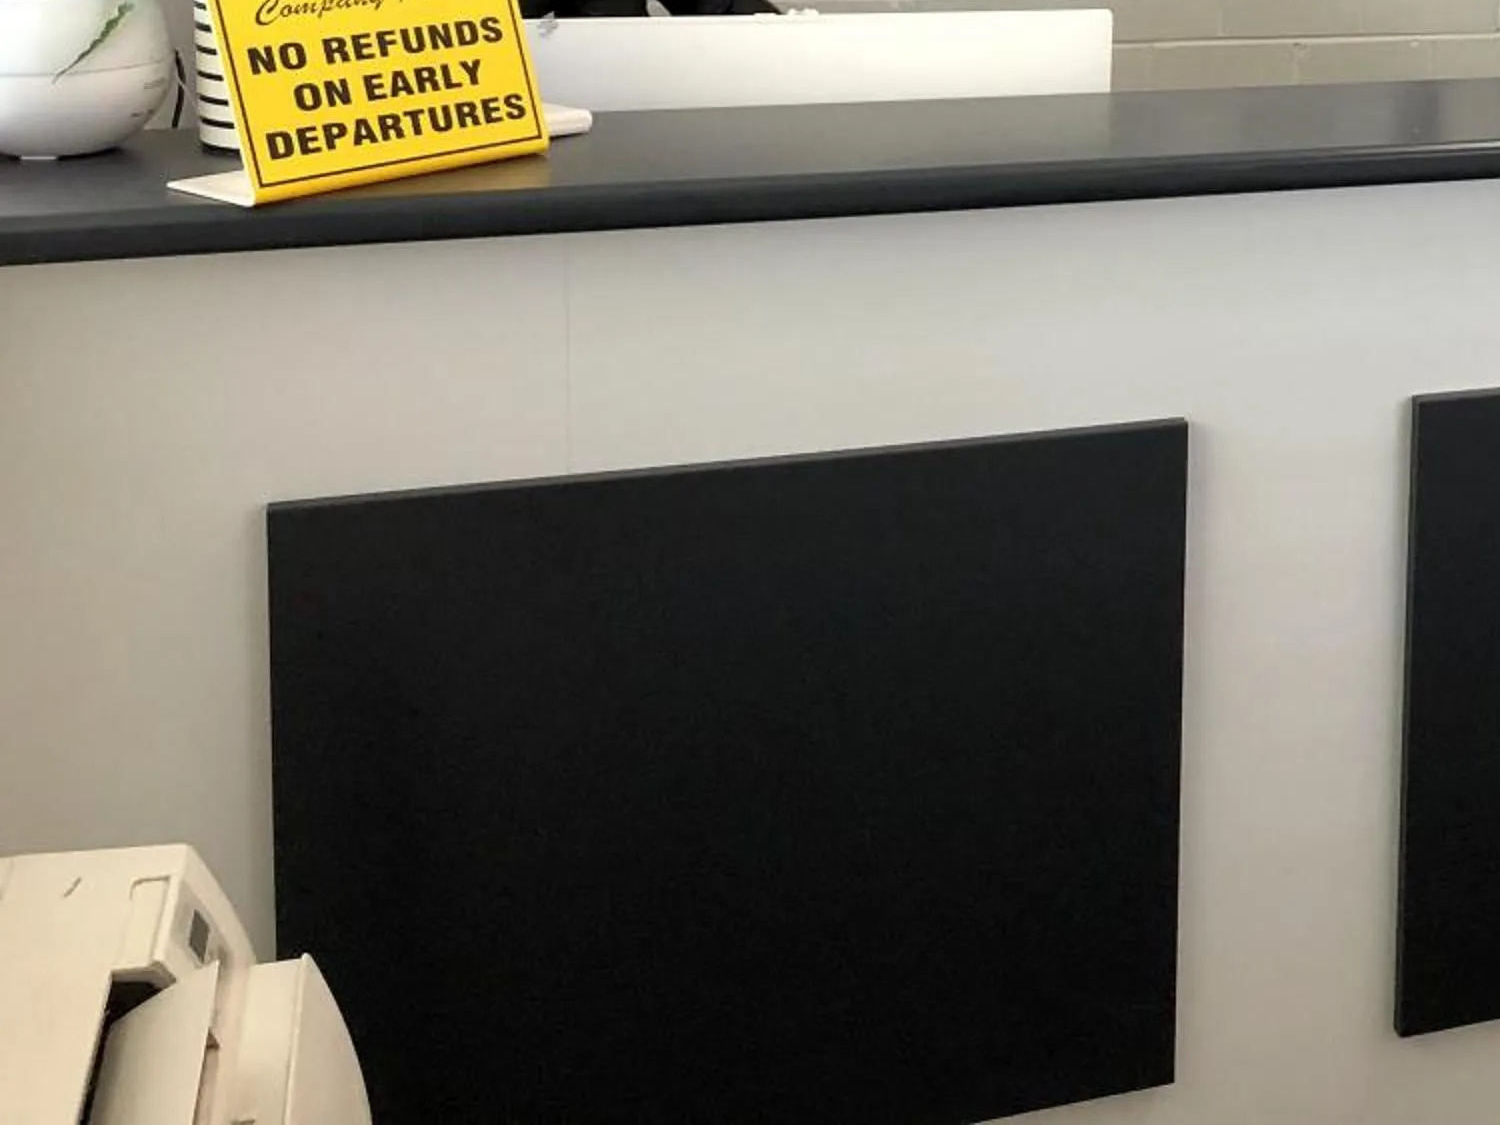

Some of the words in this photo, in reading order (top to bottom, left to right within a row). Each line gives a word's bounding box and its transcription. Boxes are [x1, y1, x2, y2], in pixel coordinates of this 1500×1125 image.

[247, 41, 308, 76] NO
[322, 15, 503, 66] REFUNDS
[293, 78, 353, 112] ON
[363, 58, 483, 101] EARLY
[265, 93, 527, 161] DEPARTURES
